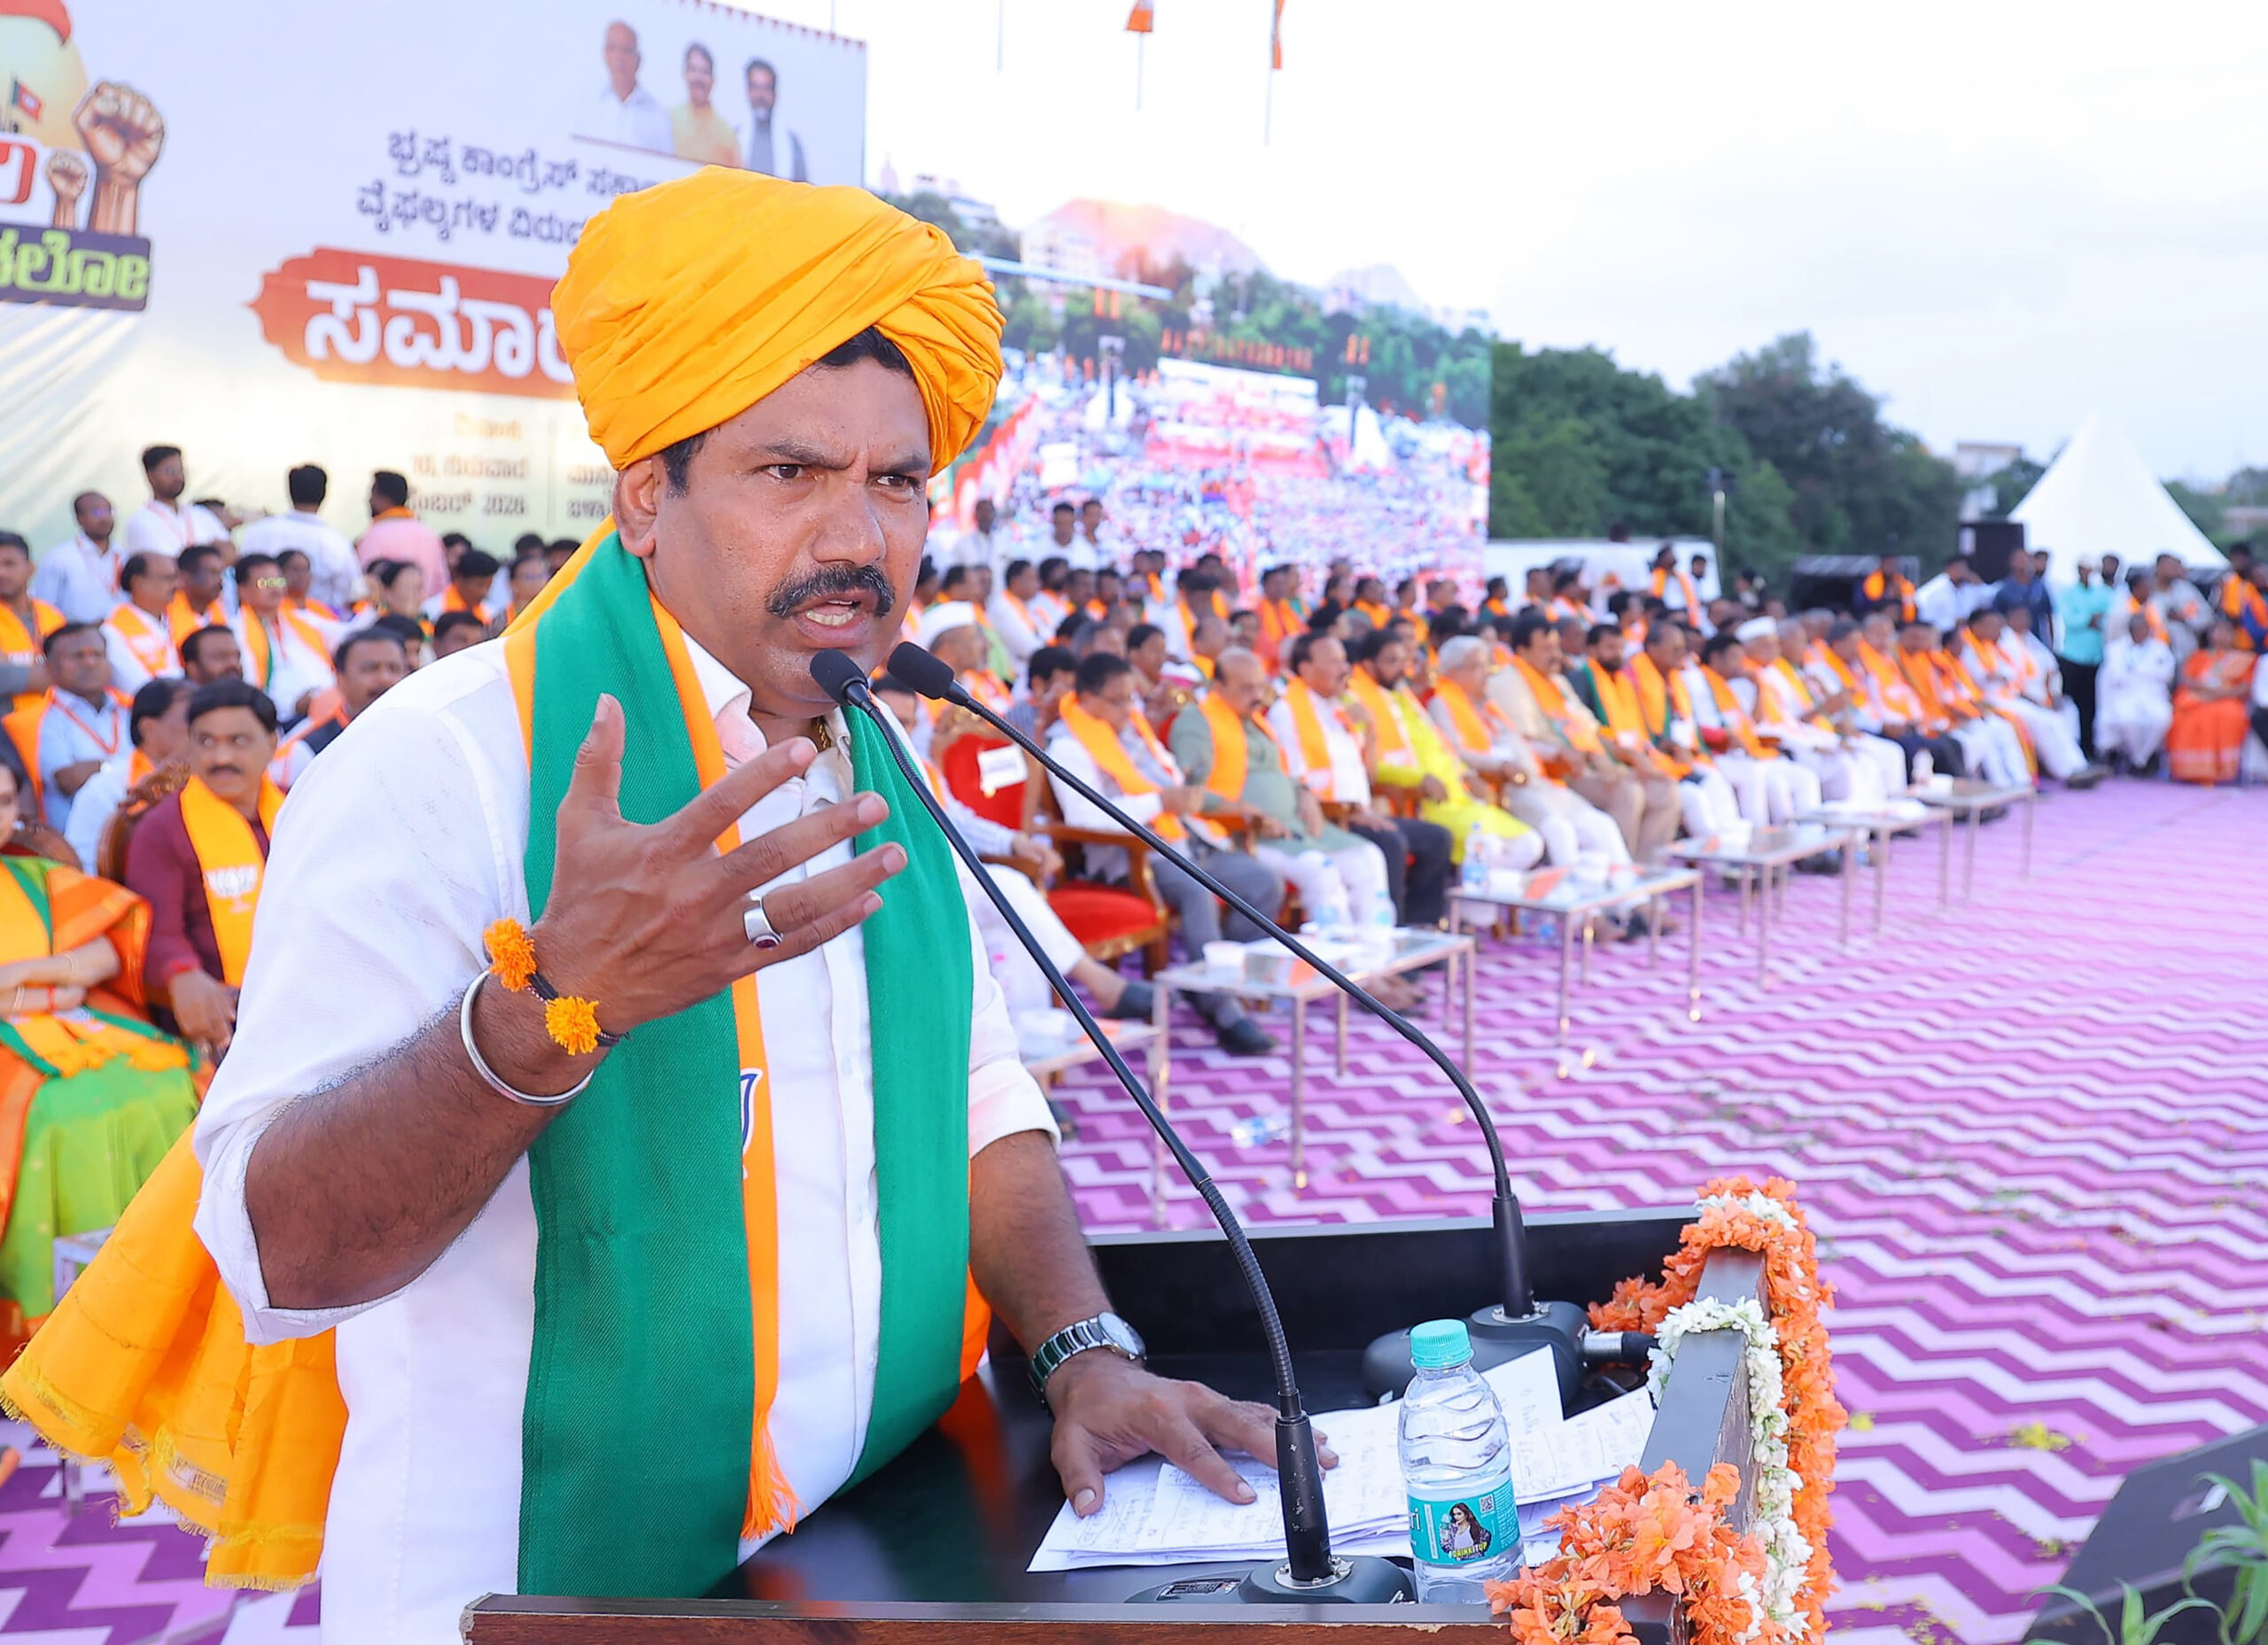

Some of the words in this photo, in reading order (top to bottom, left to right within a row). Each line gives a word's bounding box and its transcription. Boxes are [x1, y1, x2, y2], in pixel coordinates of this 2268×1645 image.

[387, 131, 456, 185] ಭ್ರಷ್ಟ
[461, 145, 578, 194] ಕಾಂಗ್ರೆಸ್
[357, 180, 501, 241] ವೈಫಲ್ಯಗಳ
